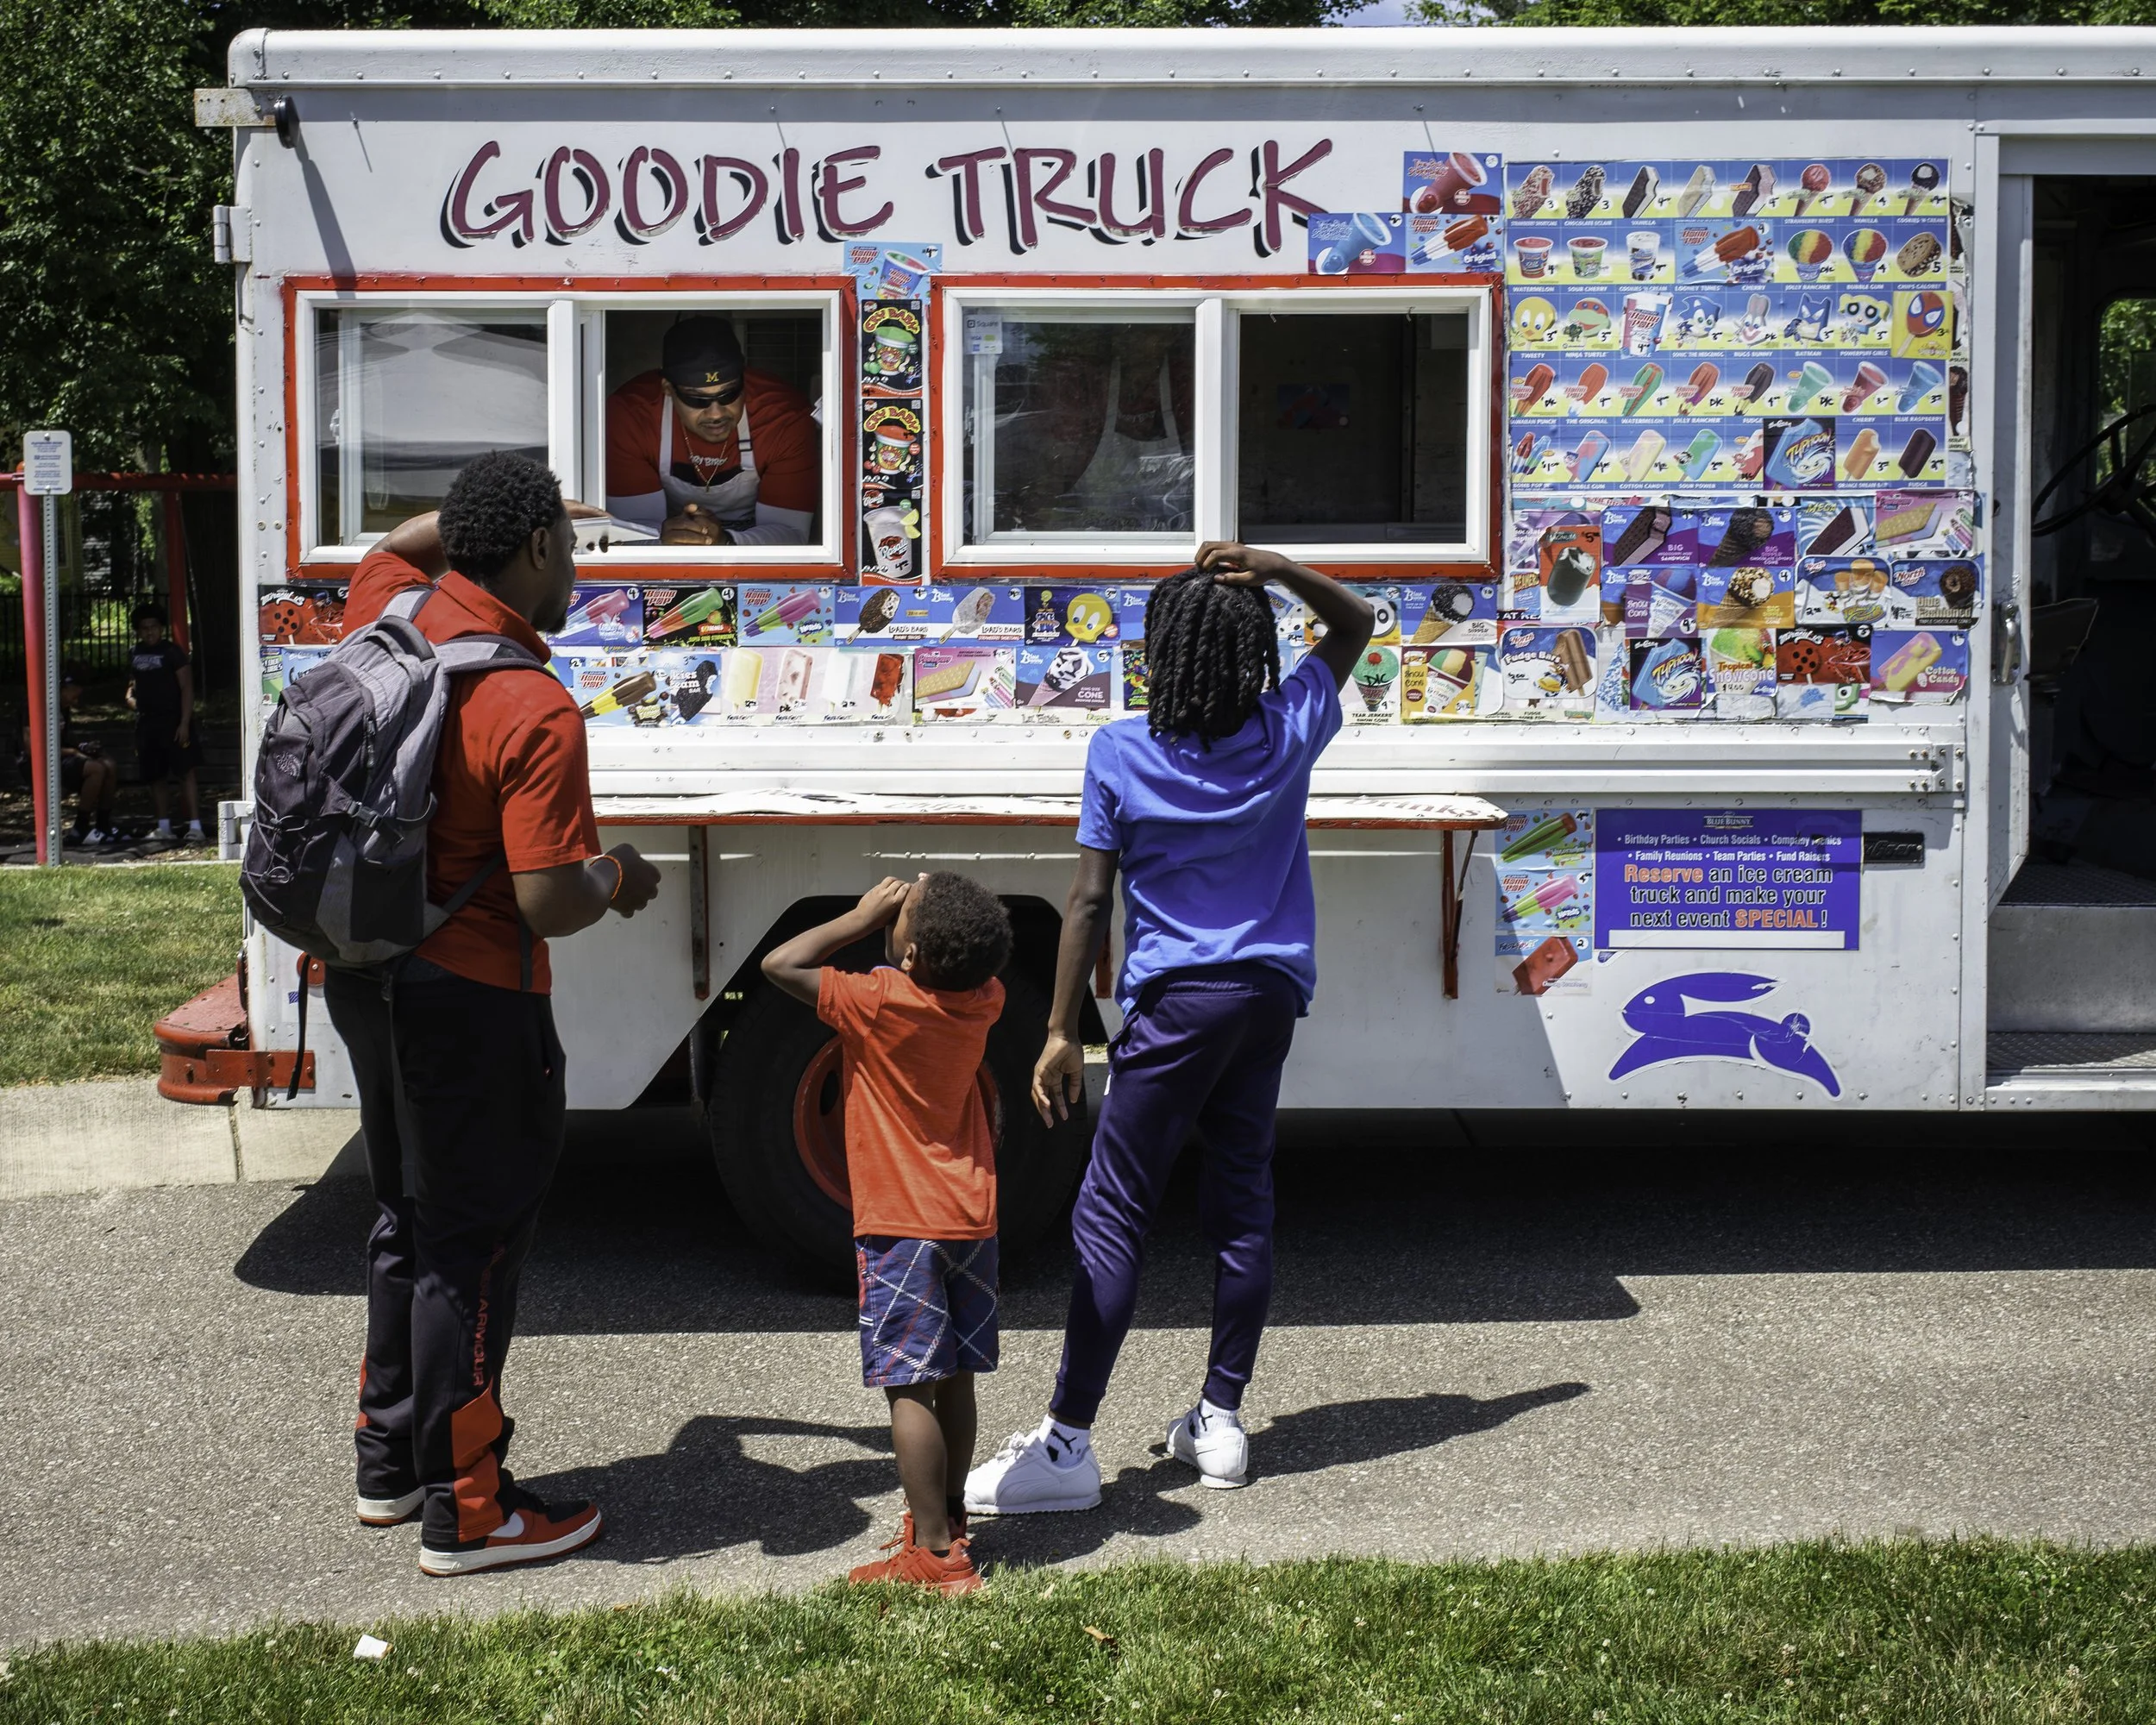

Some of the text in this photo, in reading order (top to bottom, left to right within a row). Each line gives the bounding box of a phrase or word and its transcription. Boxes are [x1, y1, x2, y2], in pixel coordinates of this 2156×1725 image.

[441, 139, 1333, 255] GOODIE TRUCK
[849, 248, 880, 257] BOMB
[852, 256, 874, 265] POP
[863, 307, 887, 333] CRY
[888, 306, 921, 335] BABY
[977, 320, 999, 329] Square
[705, 371, 720, 383] M
[863, 405, 921, 434] CRY BABY
[1785, 430, 1831, 464] TYPHOON
[1667, 543, 1684, 552] BIG
[1894, 567, 1926, 582] North
[645, 590, 678, 599] BOMB
[649, 597, 671, 606] POP
[1504, 651, 1562, 666] Fudge Bars
[1651, 649, 1698, 681] TYPHOON
[1719, 661, 1753, 672] Tropical
[1925, 665, 1958, 674] Cotton
[580, 674, 609, 682] BOMB
[1709, 668, 1775, 684] Snowcone
[1928, 674, 1960, 686] Candy
[582, 681, 605, 689] POP
[1077, 691, 1104, 699] CONE
[1705, 817, 1752, 825] BLUE BUNNY
[1624, 834, 1810, 848] Birthday Parties Church Socials Company
[1635, 850, 1831, 862] Family Reunions Team Parties Fund Raisers
[1624, 863, 1833, 884] Reserve an ice cream
[1630, 886, 1827, 908] truck and make your
[1630, 911, 1671, 927] next
[1677, 910, 1730, 928] event
[473, 1297, 490, 1387] ARMOUR
